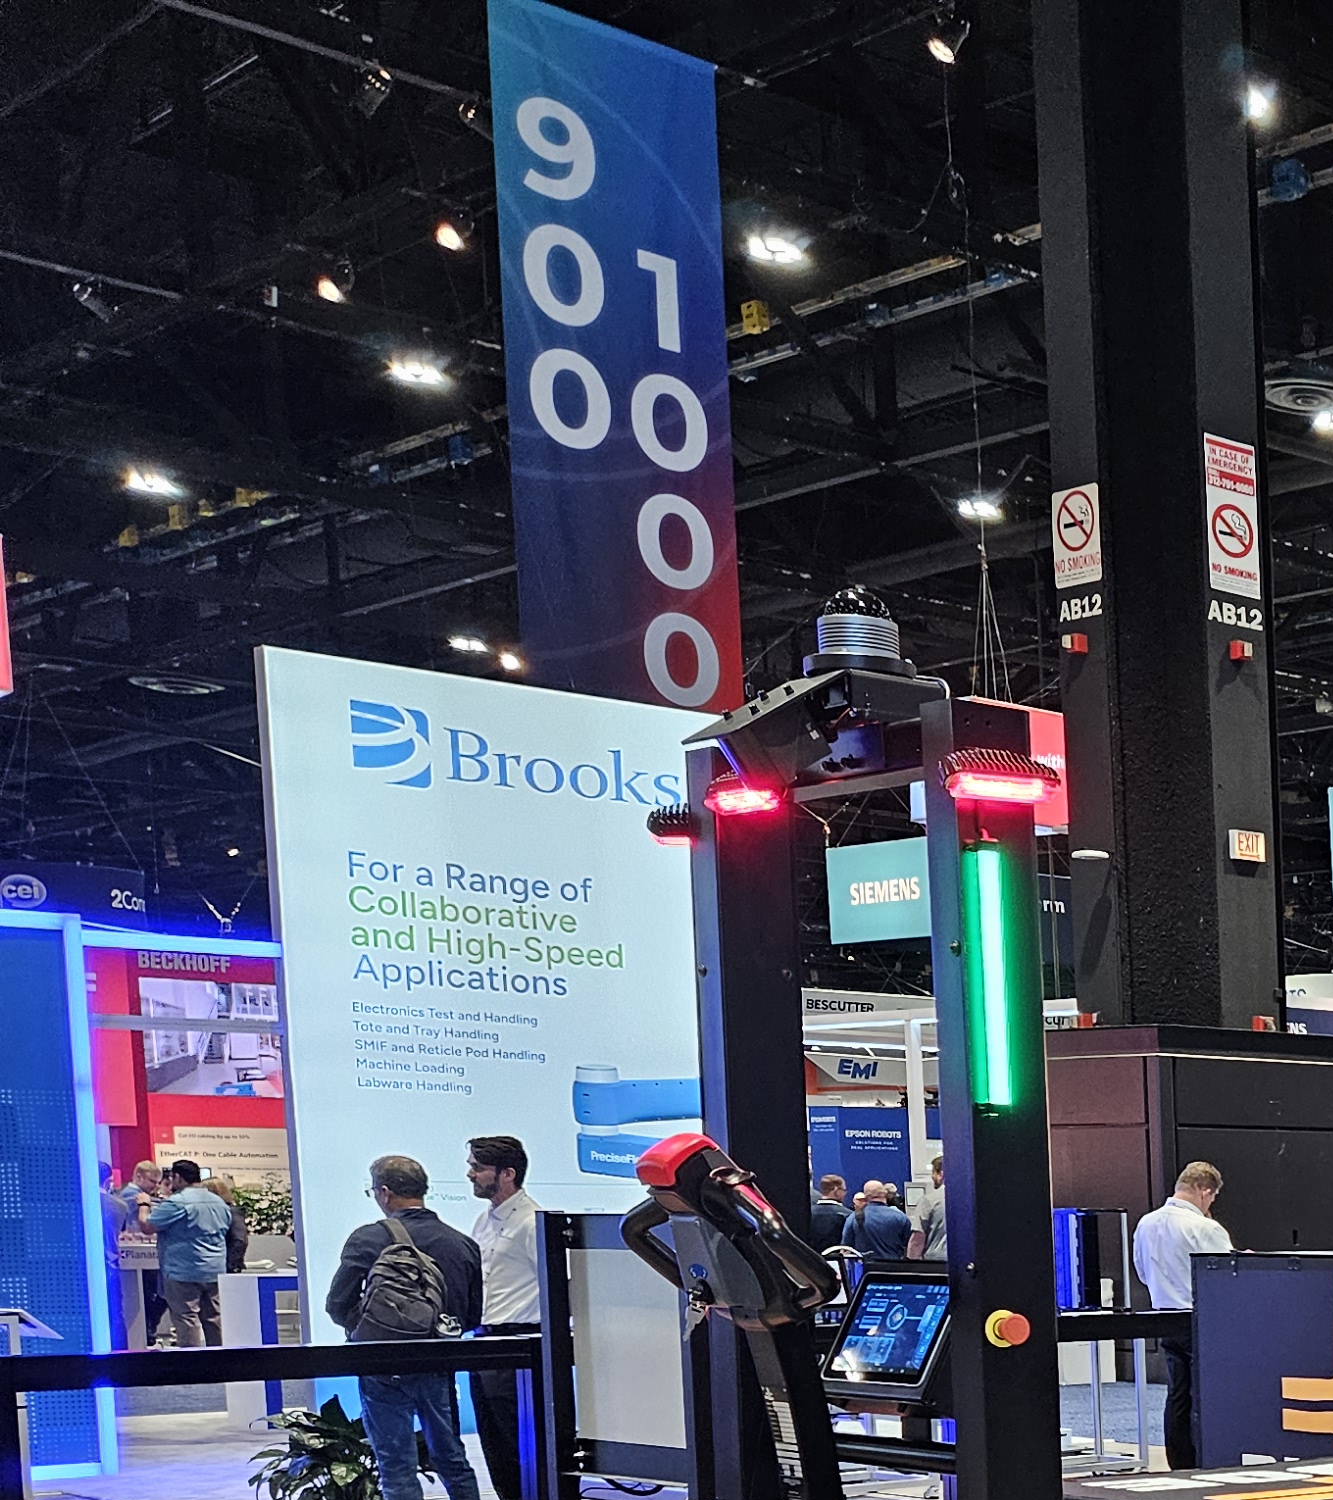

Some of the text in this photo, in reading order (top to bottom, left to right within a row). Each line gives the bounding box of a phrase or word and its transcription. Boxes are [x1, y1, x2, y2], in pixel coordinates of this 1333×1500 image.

[1207, 455, 1254, 476] EMERGENCY
[1219, 448, 1239, 463] CASE
[1055, 552, 1101, 574] NO SMOKING
[1212, 562, 1258, 582] NO SMOKING
[1059, 593, 1103, 622] AB12
[1208, 599, 1264, 631] AB12
[444, 727, 684, 808] Brooks
[1237, 831, 1260, 856] EXIT
[348, 850, 593, 903] For a Range of
[850, 876, 921, 906] SIEMENS
[348, 885, 578, 933] Collaborative
[351, 925, 624, 970] and High-Speed
[138, 951, 231, 973] BECKHOFF
[353, 954, 568, 996] Applications
[352, 1001, 538, 1028] Electronics Test and Handling
[806, 998, 875, 1013] BESCUTTER
[353, 1020, 499, 1043] Tote and Tray Handling
[354, 1038, 546, 1064] SMIF and Reticle Pod Handling
[356, 1057, 465, 1077] Machine Loading
[837, 1058, 878, 1080] EMI
[357, 1076, 472, 1096] Labware Handling
[845, 1129, 902, 1139] EPSON ROBOTS
